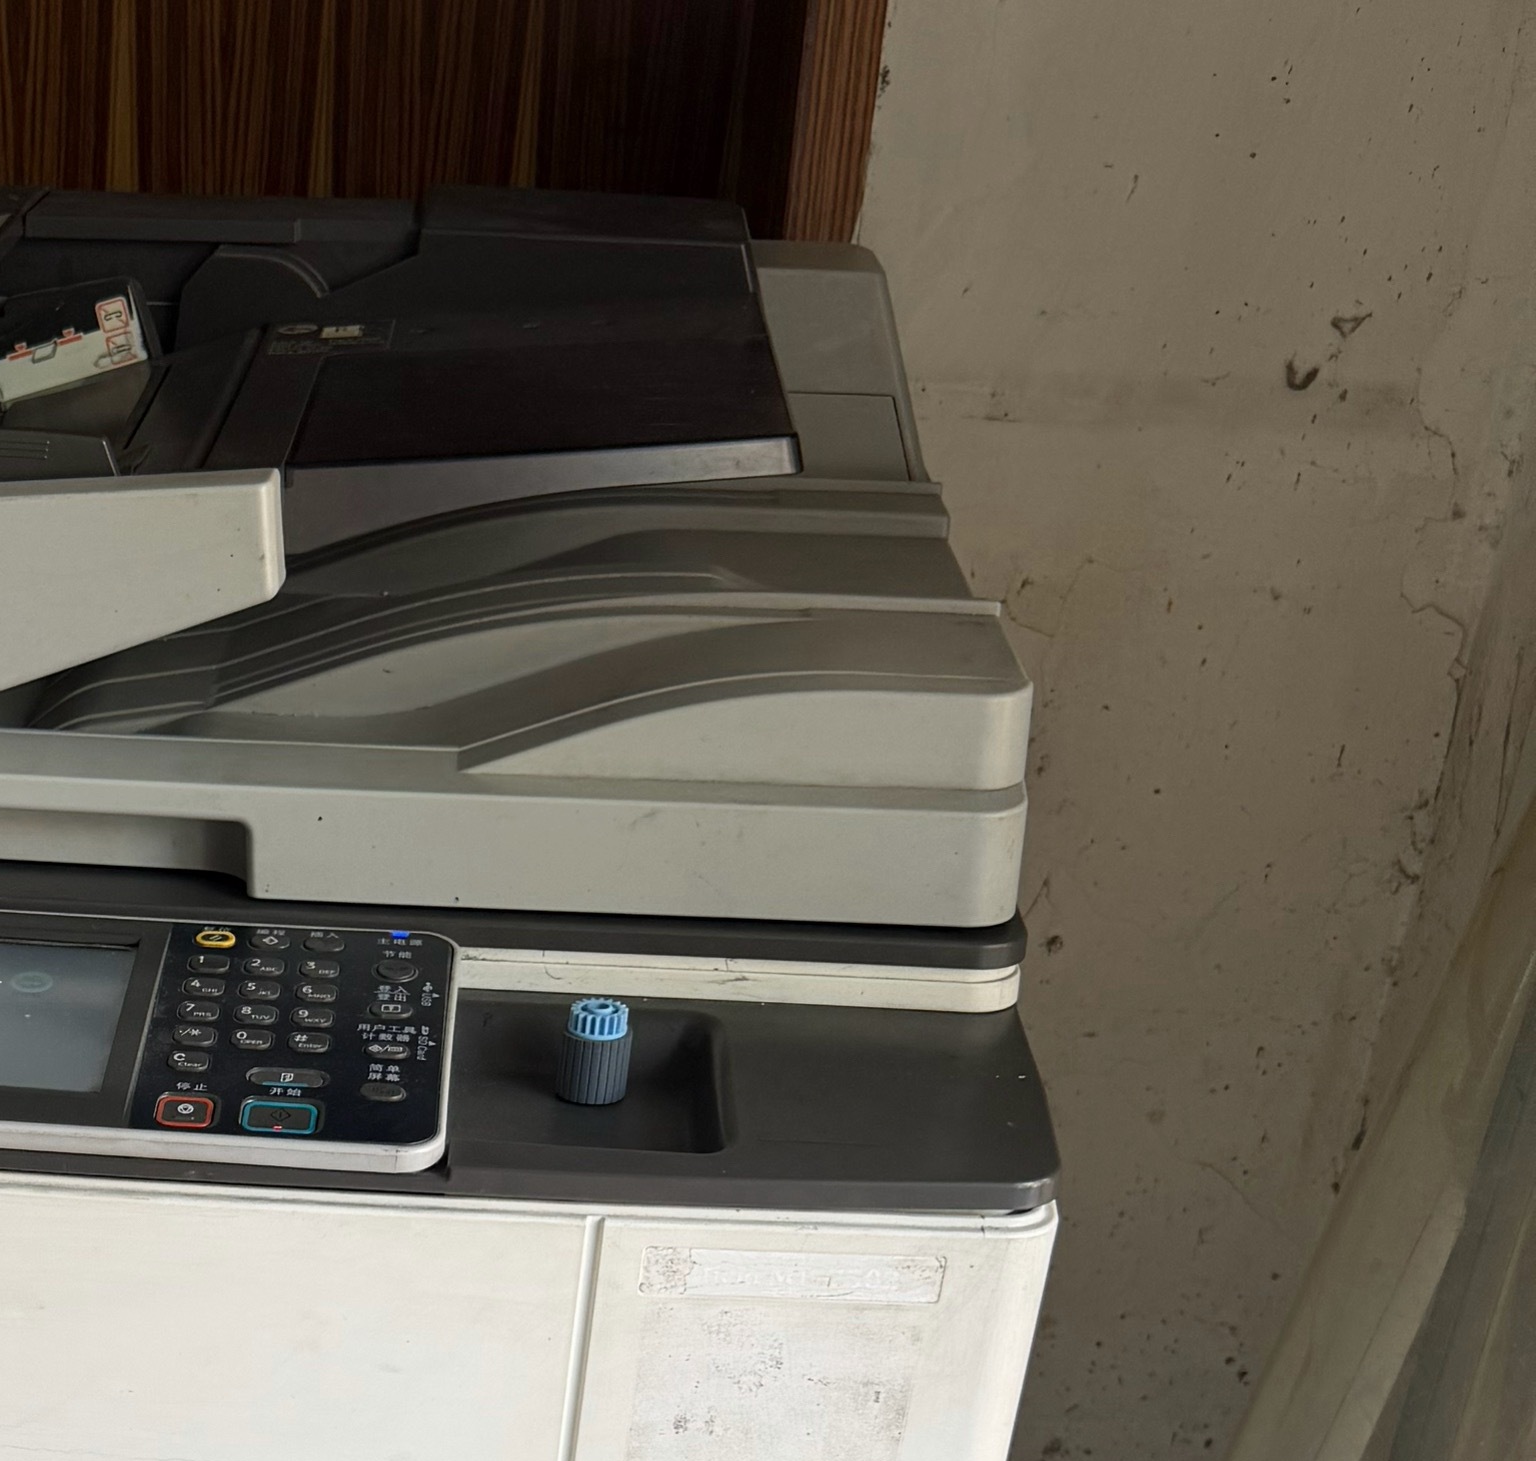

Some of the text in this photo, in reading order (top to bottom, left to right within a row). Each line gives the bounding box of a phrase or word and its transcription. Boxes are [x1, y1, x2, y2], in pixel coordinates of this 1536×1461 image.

[198, 955, 204, 963] 1
[305, 961, 316, 969] 3
[191, 979, 200, 988] 4
[303, 986, 312, 994] 6
[185, 1003, 195, 1011] 7
[241, 1007, 252, 1015] 8
[298, 1010, 309, 1018] 9
[357, 1024, 417, 1034] 用户工具
[173, 1053, 185, 1061] C
[176, 1082, 208, 1090] 停止
[269, 1088, 302, 1096] 开始
